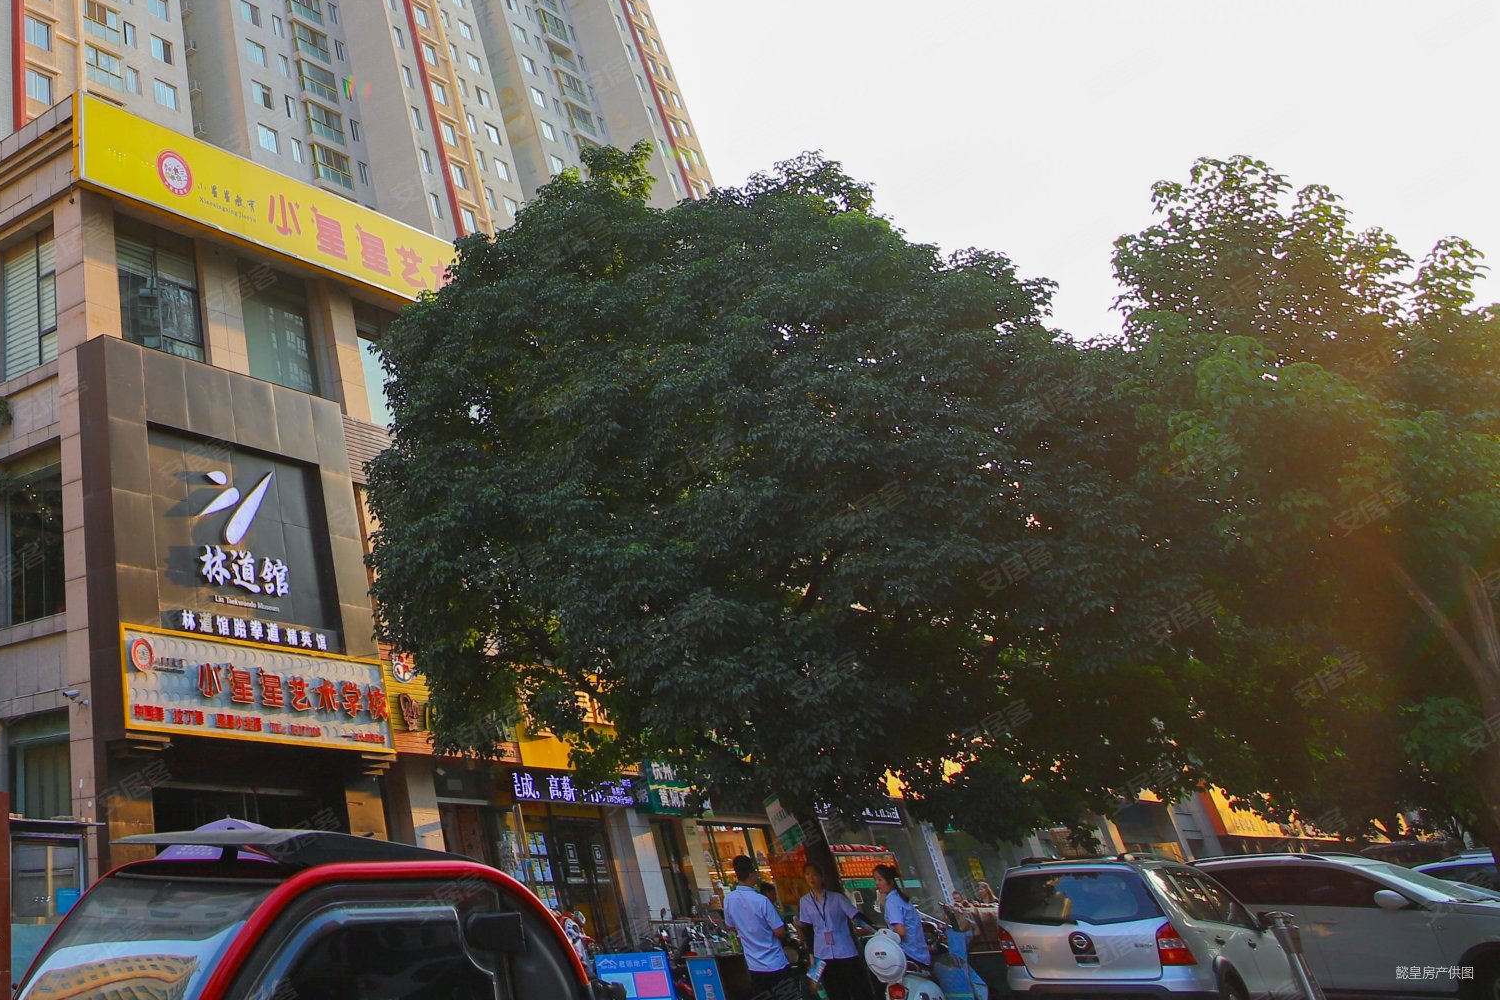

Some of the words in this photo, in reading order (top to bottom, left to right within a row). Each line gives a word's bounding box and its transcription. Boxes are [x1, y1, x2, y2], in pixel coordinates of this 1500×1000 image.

[225, 596, 257, 610] Taekwondo
[286, 627, 329, 652] 精英馆
[196, 662, 390, 722] 小星星艺术学校
